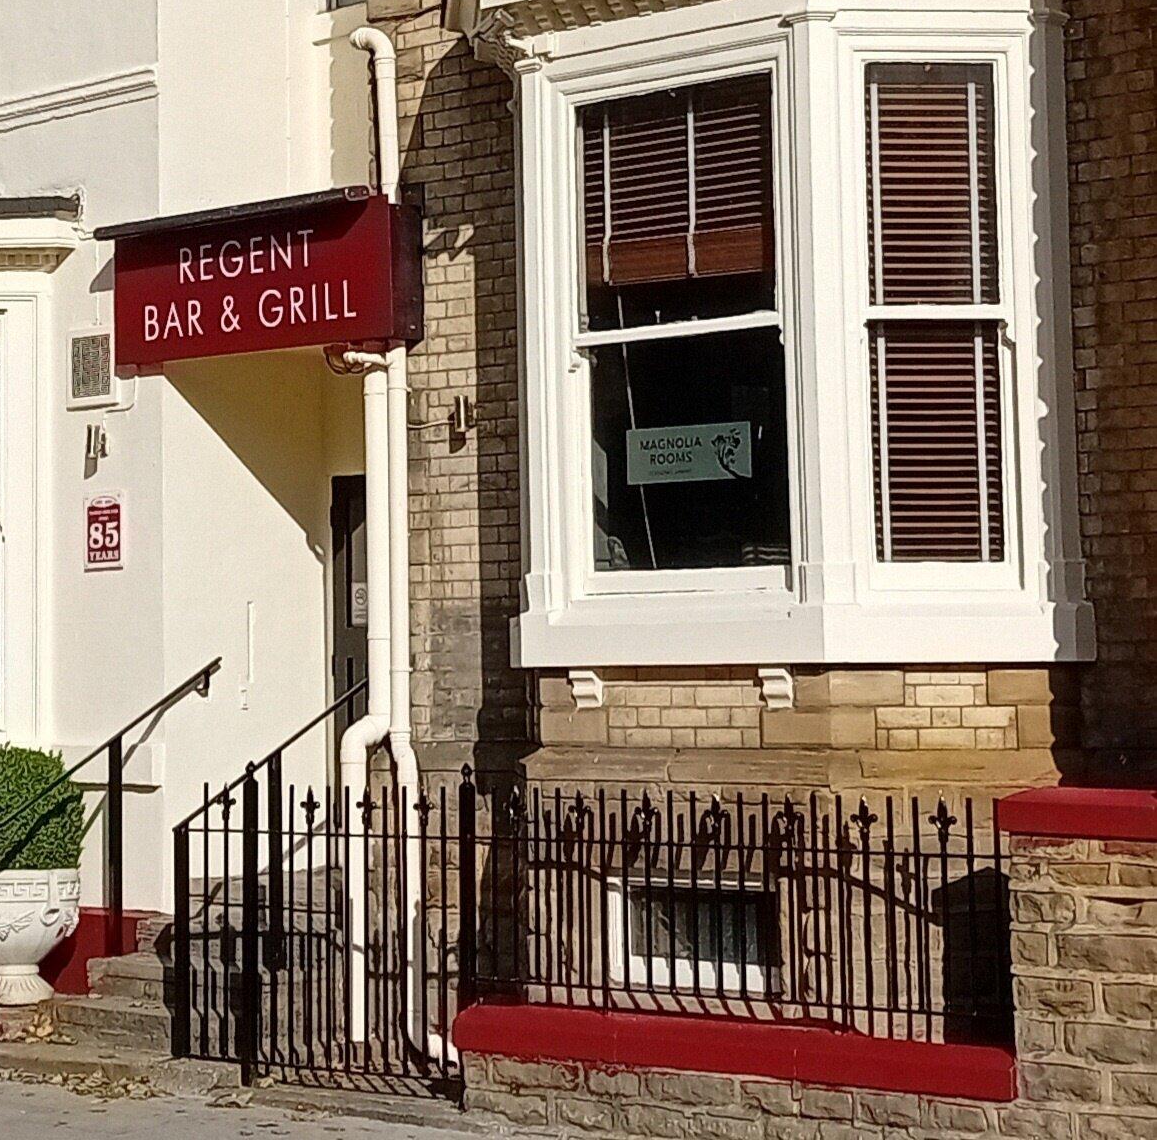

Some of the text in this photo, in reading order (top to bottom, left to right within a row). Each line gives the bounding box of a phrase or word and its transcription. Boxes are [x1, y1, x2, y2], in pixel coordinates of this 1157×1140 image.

[179, 229, 314, 284] REGENT
[144, 279, 357, 341] BAR & GRILL
[640, 437, 702, 450] MAGNOLIA
[650, 451, 693, 465] ROOMS
[88, 521, 119, 549] 85
[89, 550, 119, 561] YEARS
